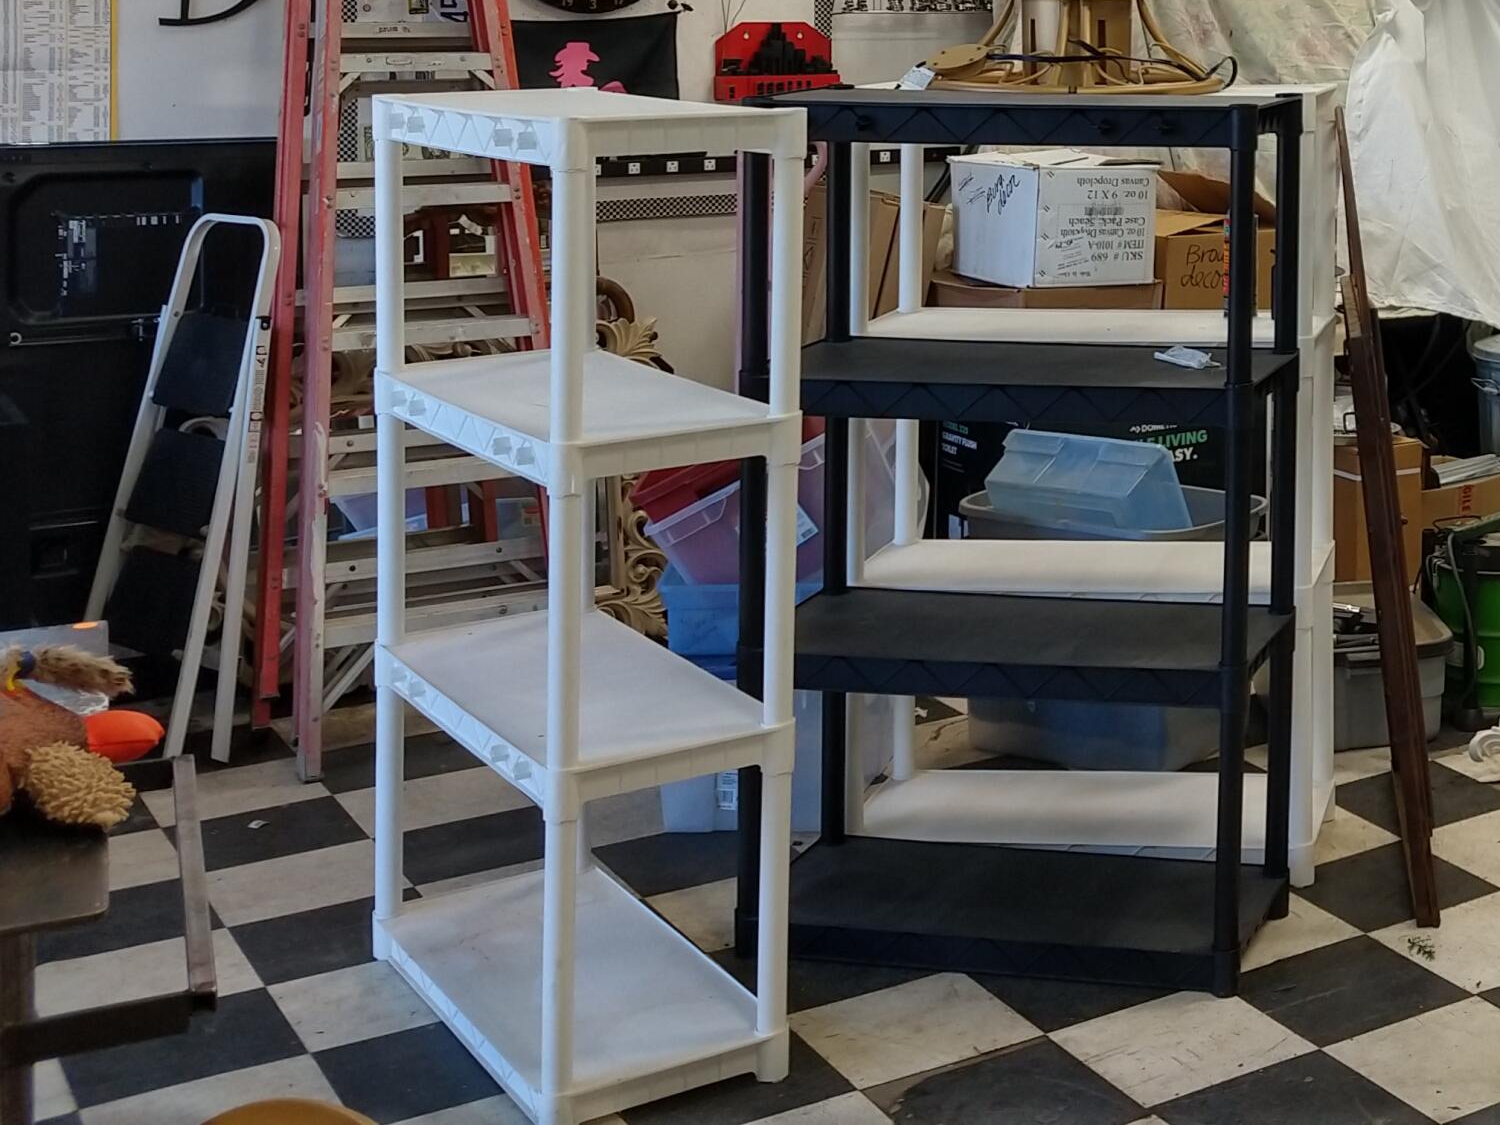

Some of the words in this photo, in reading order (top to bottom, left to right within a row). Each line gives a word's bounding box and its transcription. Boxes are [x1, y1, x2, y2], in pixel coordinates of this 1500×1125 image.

[1076, 175, 1119, 187] Dropcloth
[1121, 177, 1150, 187] Canvas
[1087, 189, 1098, 200] 12
[1111, 189, 1118, 199] 9
[1138, 190, 1148, 200] 10
[1125, 217, 1146, 227] Case
[1060, 227, 1098, 238] Dropcloth
[1098, 228, 1125, 238] Canvas
[1124, 239, 1145, 249] ITEM
[1122, 251, 1144, 261] SKU
[1180, 265, 1225, 289] deco
[1167, 446, 1198, 463] ASY.
[1461, 485, 1472, 512] GILE
